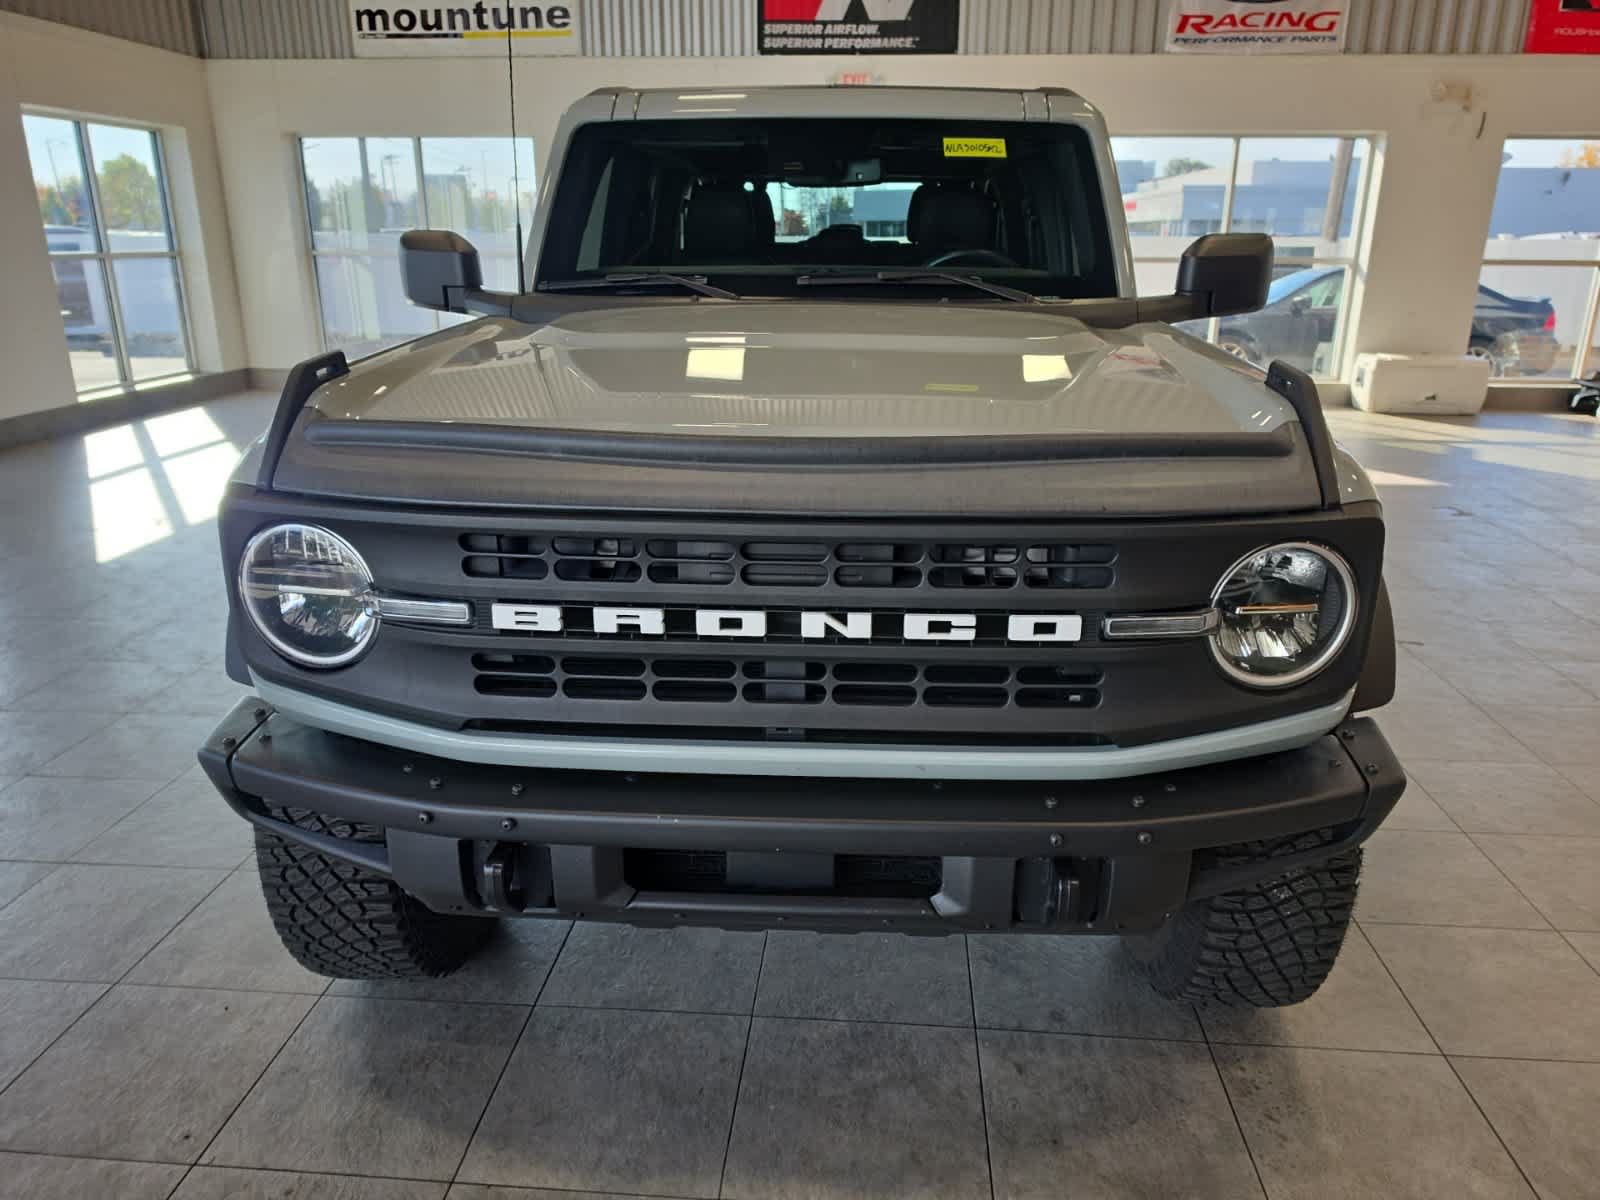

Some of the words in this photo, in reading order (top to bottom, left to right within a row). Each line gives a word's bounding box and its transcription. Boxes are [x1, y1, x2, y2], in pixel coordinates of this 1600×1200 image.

[356, 1, 571, 31] mountune
[1175, 12, 1341, 35] RACING
[763, 24, 823, 35] SUPERIOR
[763, 37, 823, 48] SUPERIOR
[1174, 35, 1288, 44] PERFORMANCE
[1290, 35, 1337, 43] PARTS
[491, 602, 1082, 642] BRONCO
